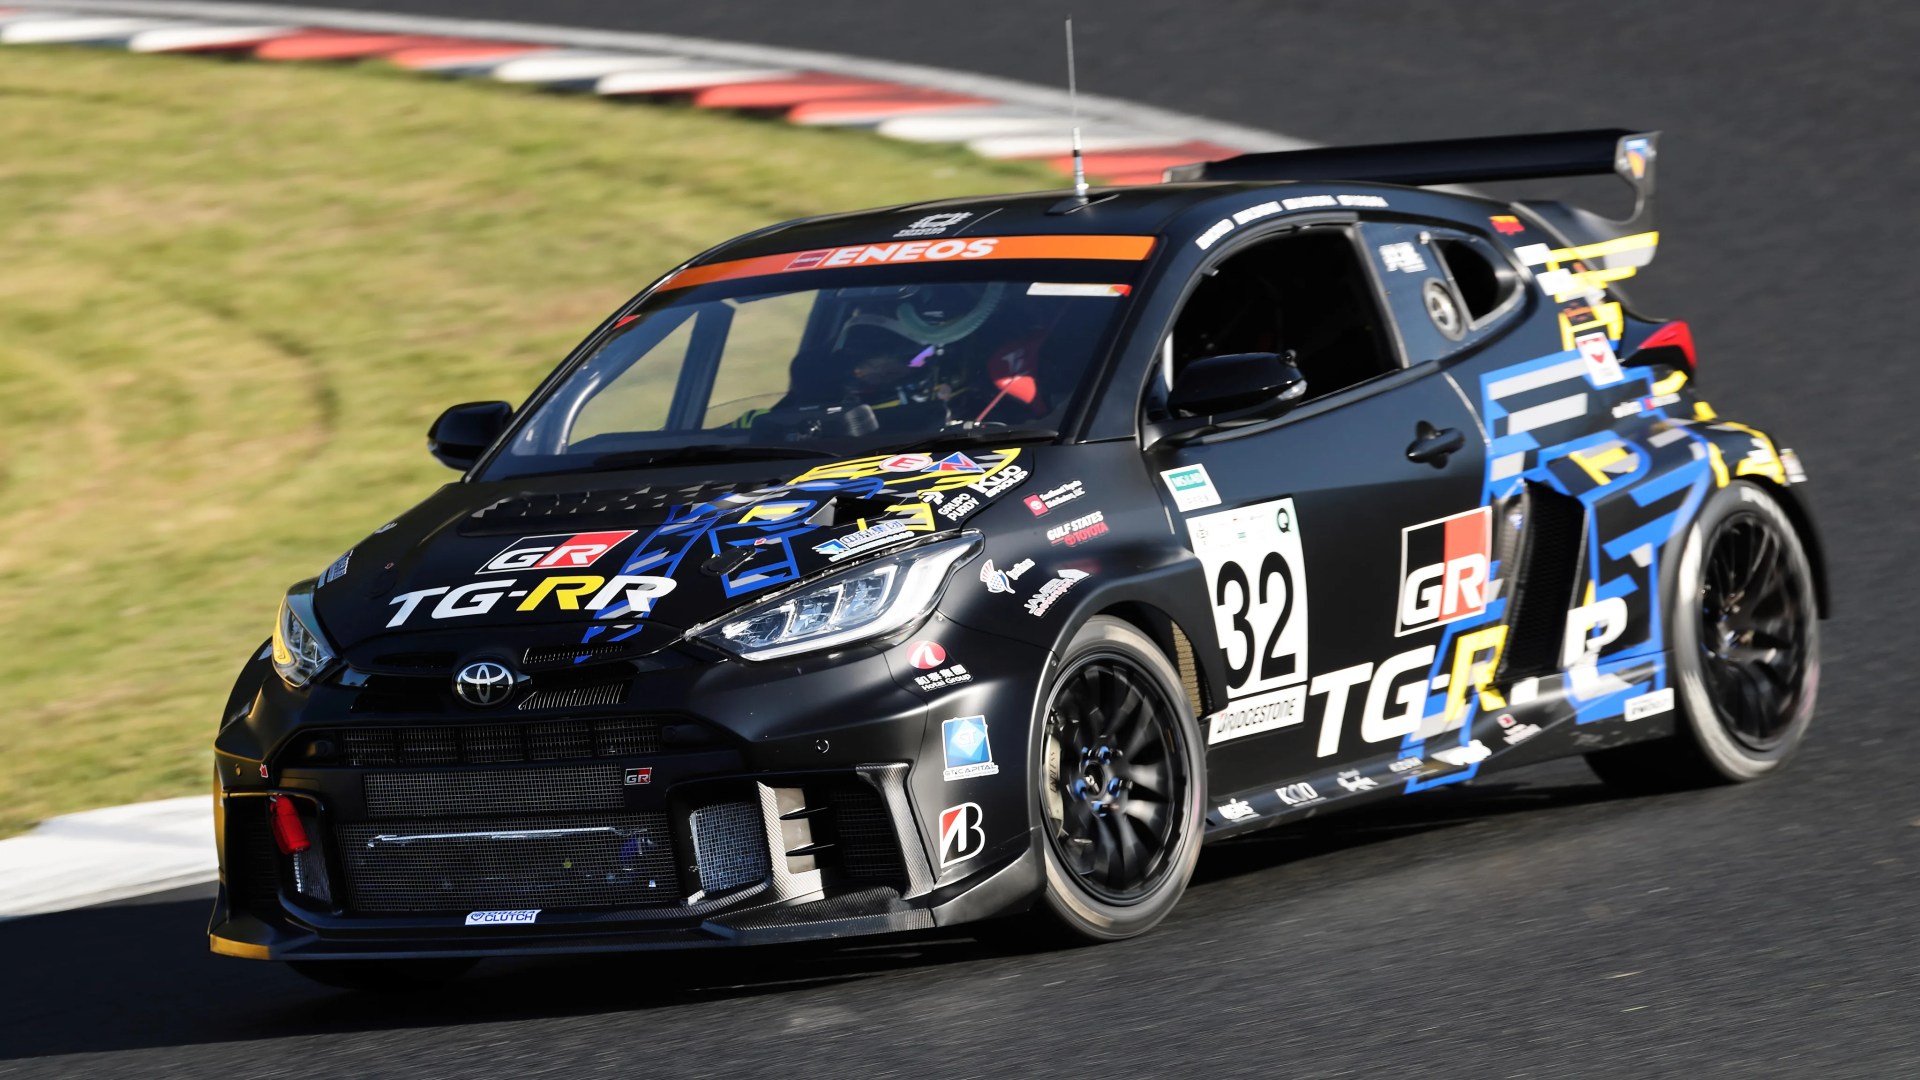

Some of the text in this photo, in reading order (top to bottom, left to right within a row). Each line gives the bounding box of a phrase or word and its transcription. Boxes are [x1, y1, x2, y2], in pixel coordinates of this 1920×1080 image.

[824, 238, 1000, 267] ENEOS
[967, 465, 1022, 494] KUO
[985, 470, 1028, 498] GROUP
[938, 493, 970, 515] GRUPO
[947, 497, 980, 521] PURDY
[1047, 511, 1104, 541] GULF STATES
[1073, 522, 1109, 542] TOYOTA
[1276, 507, 1292, 533] Q
[486, 543, 610, 570] GR
[385, 575, 678, 628] TG-RR
[1402, 552, 1487, 627] GR
[1216, 551, 1297, 690] 32
[921, 673, 971, 691] Hotai Group
[1217, 698, 1296, 734] BRIDGESTONE
[626, 773, 650, 784] GR
[1048, 751, 1058, 793] ENDLESS
[484, 913, 534, 923] CLUTCH
